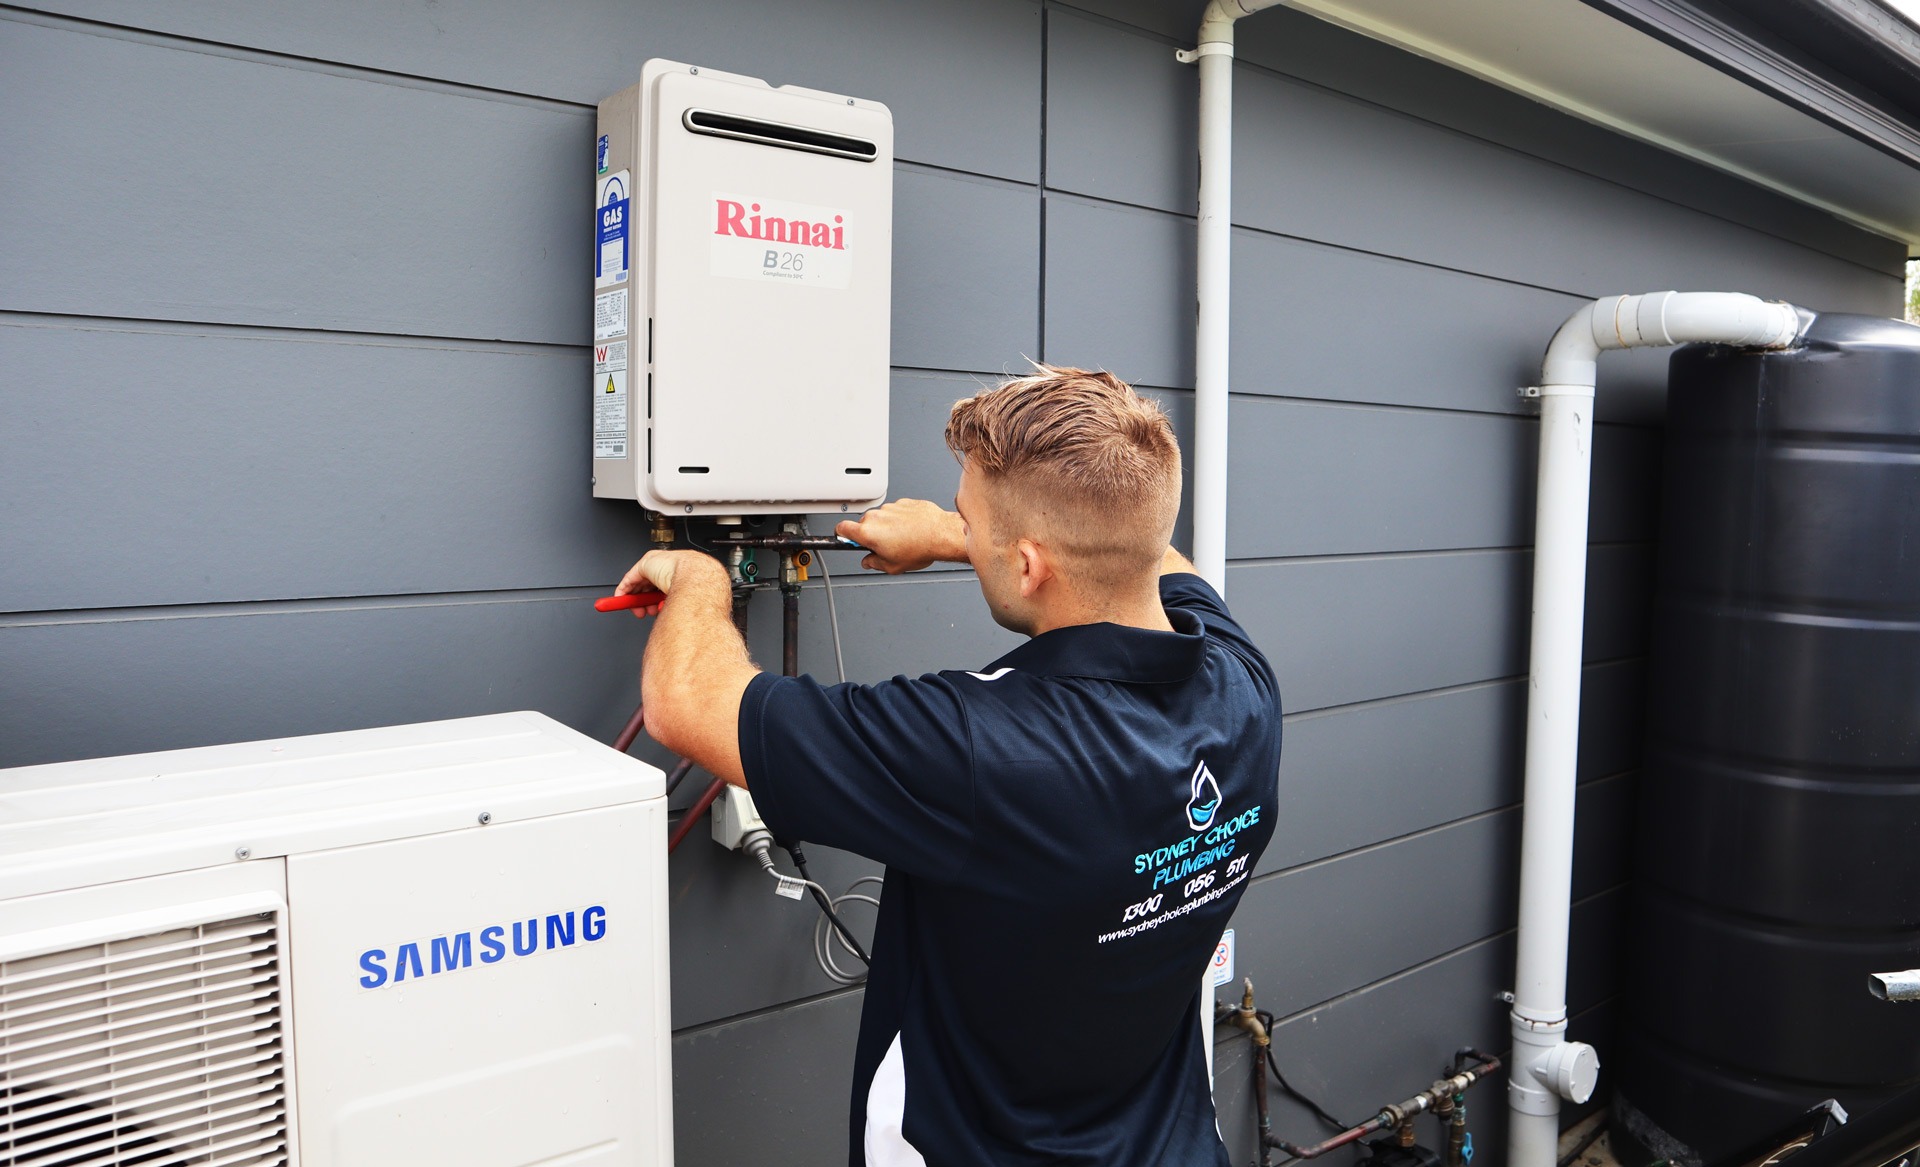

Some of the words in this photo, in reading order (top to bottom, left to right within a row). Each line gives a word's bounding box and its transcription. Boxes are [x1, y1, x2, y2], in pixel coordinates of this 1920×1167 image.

[603, 205, 623, 227] GAS
[714, 199, 846, 250] Rinnai
[763, 249, 779, 268] B
[780, 251, 804, 271] 26
[1134, 833, 1203, 875] SYDNEY
[1204, 805, 1261, 845] CHOICE
[1152, 838, 1236, 890] PLUMBING
[1122, 893, 1163, 922] 1300
[1184, 869, 1217, 898] 056
[1225, 853, 1250, 878] 511
[359, 905, 606, 989] SAMSUNG
